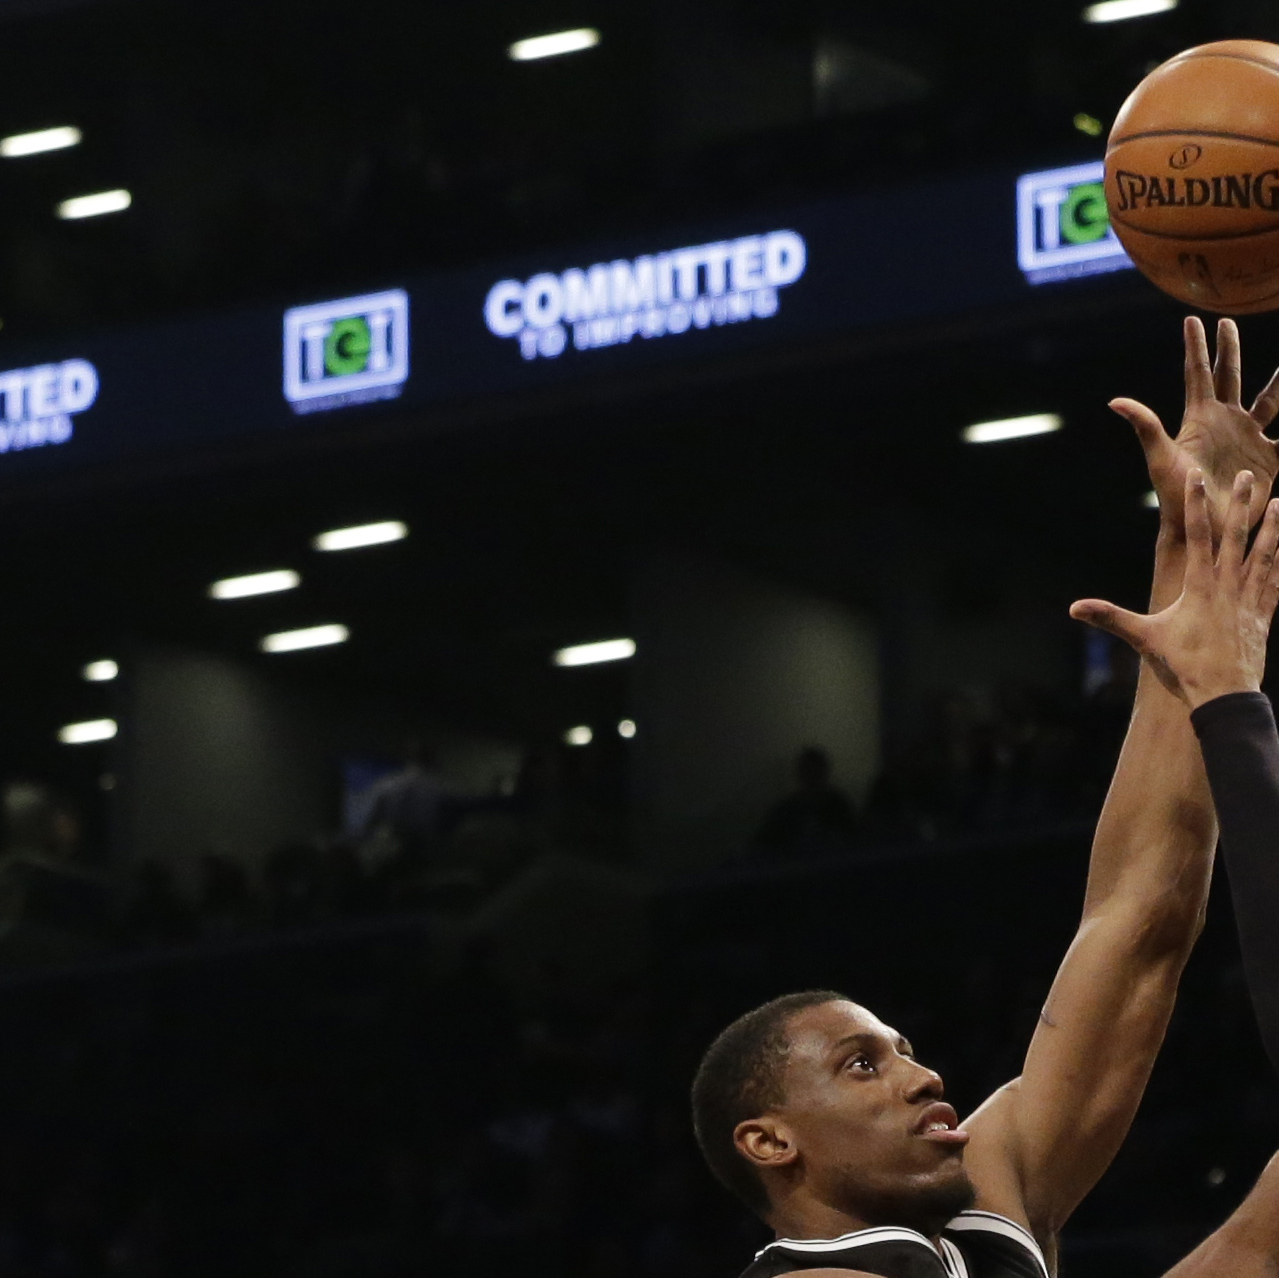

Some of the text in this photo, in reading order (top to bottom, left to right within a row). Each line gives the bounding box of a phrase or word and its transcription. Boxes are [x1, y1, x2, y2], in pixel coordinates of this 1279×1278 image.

[484, 229, 807, 338] COMMITTED
[520, 287, 779, 360] TO IMPROVING
